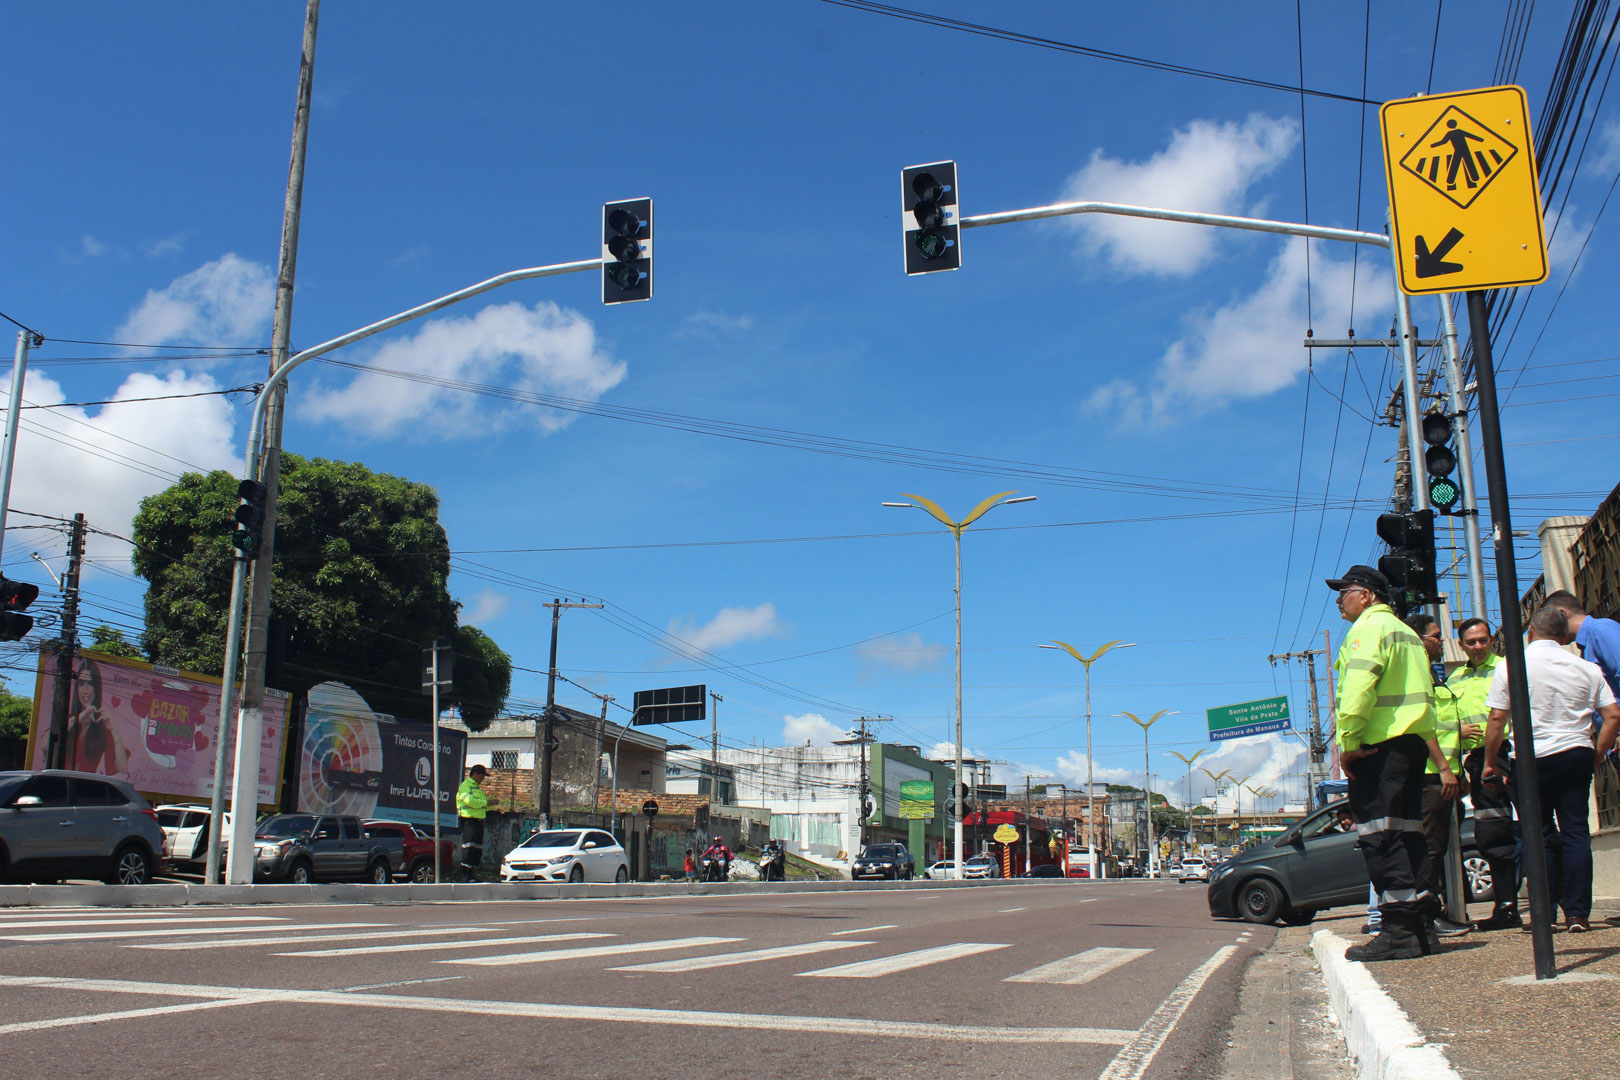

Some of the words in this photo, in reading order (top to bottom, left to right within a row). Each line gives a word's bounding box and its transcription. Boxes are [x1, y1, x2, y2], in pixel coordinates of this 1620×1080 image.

[150, 699, 191, 723] BAZAR
[1213, 730, 1245, 739] Prefeitura
[1255, 724, 1280, 732] Manaus
[394, 734, 416, 748] Tintas
[417, 739, 435, 752] Cora
